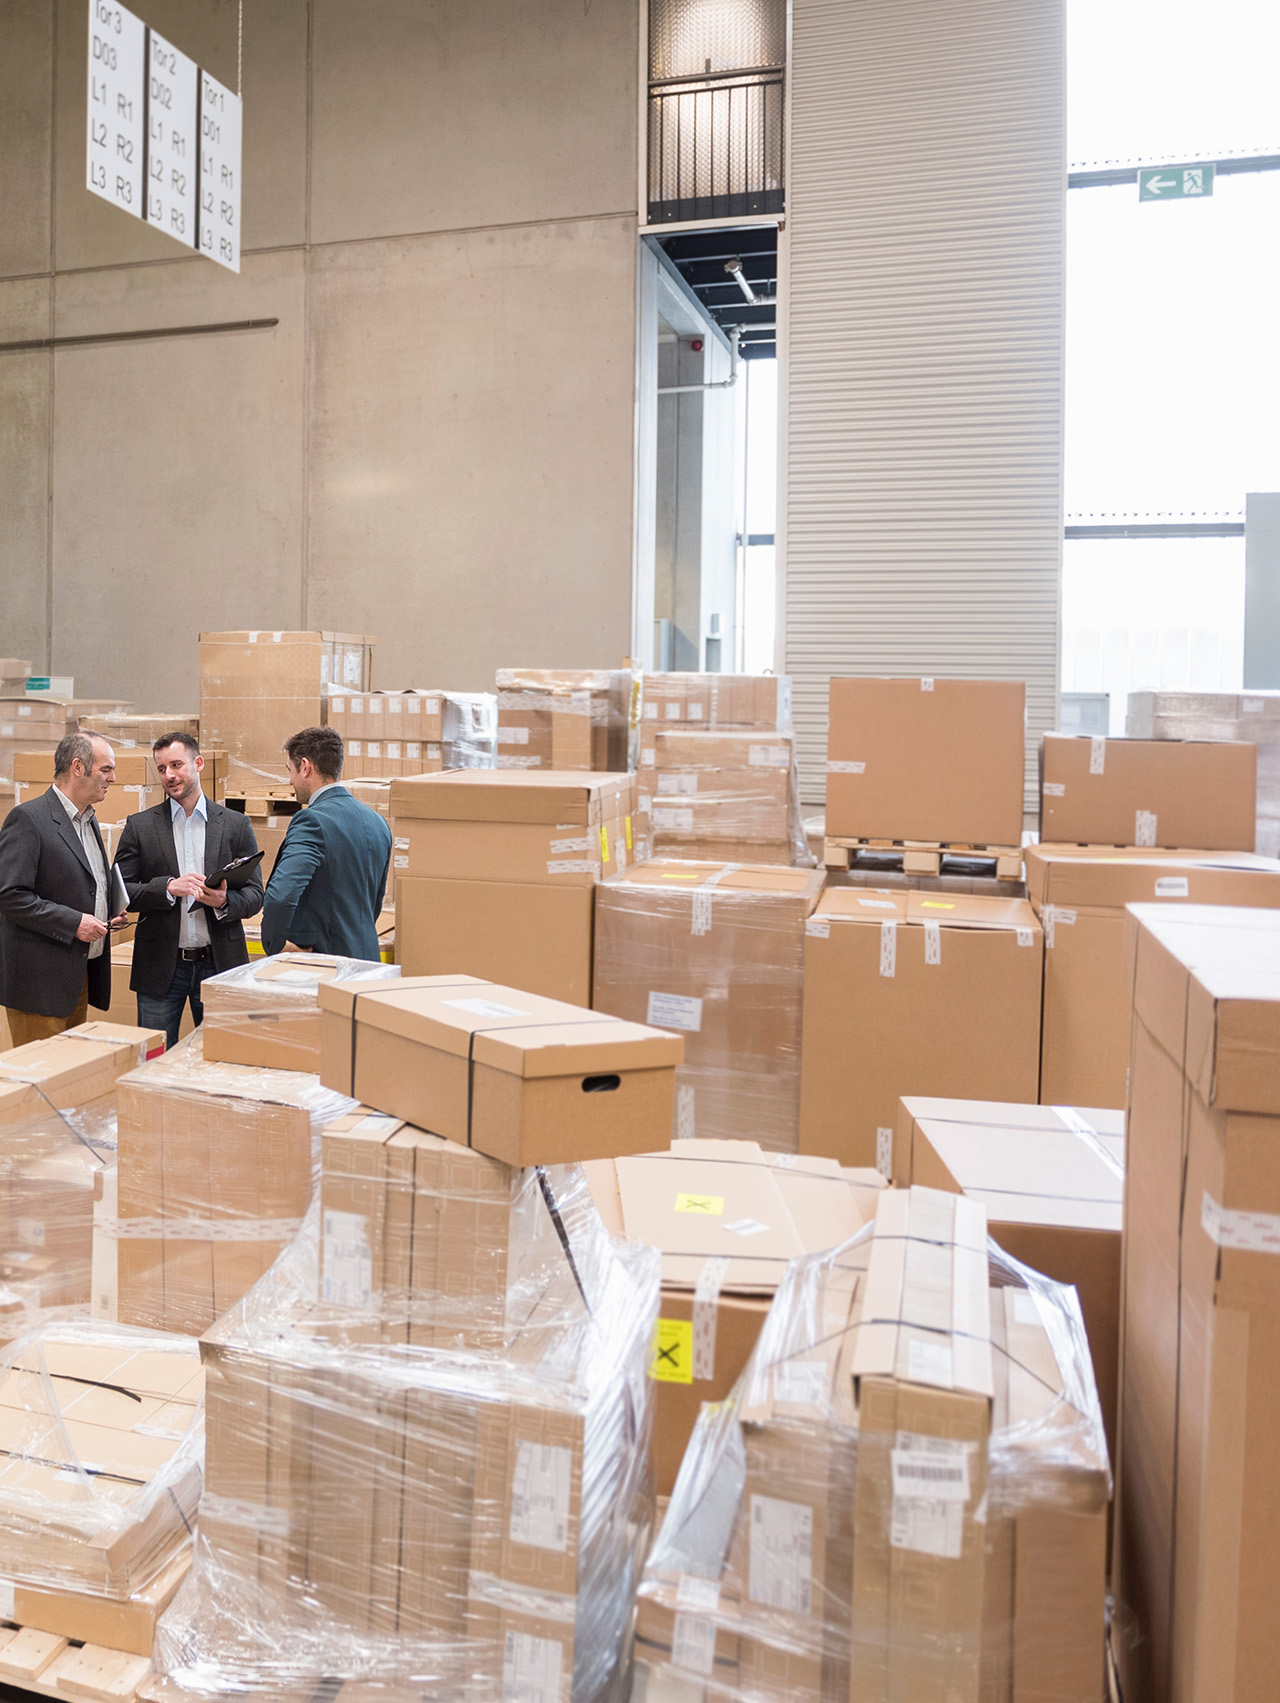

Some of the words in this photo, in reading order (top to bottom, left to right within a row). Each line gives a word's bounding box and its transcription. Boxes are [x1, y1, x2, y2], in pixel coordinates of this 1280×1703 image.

[114, 11, 122, 34] 3
[93, 35, 117, 71] D03
[151, 39, 167, 68] Tor
[169, 53, 176, 75] 2
[92, 76, 106, 105] L1
[117, 93, 133, 122] R1
[151, 77, 172, 110] D02
[204, 80, 218, 106] Tor
[219, 93, 224, 112] 1
[91, 118, 107, 148] L2
[117, 134, 133, 163] R2
[150, 116, 162, 141] L1
[172, 130, 185, 157] R1
[203, 115, 220, 145] D01
[91, 161, 106, 189] L3
[116, 175, 132, 204] R3
[150, 155, 163, 182] L2
[172, 169, 186, 196] R2
[202, 151, 213, 176] L1
[221, 164, 233, 189] R1
[149, 195, 162, 221] L3
[171, 208, 185, 234] R3
[202, 188, 214, 213] L2
[221, 200, 234, 226] R2
[201, 225, 213, 250] L3
[220, 237, 233, 261] R3
